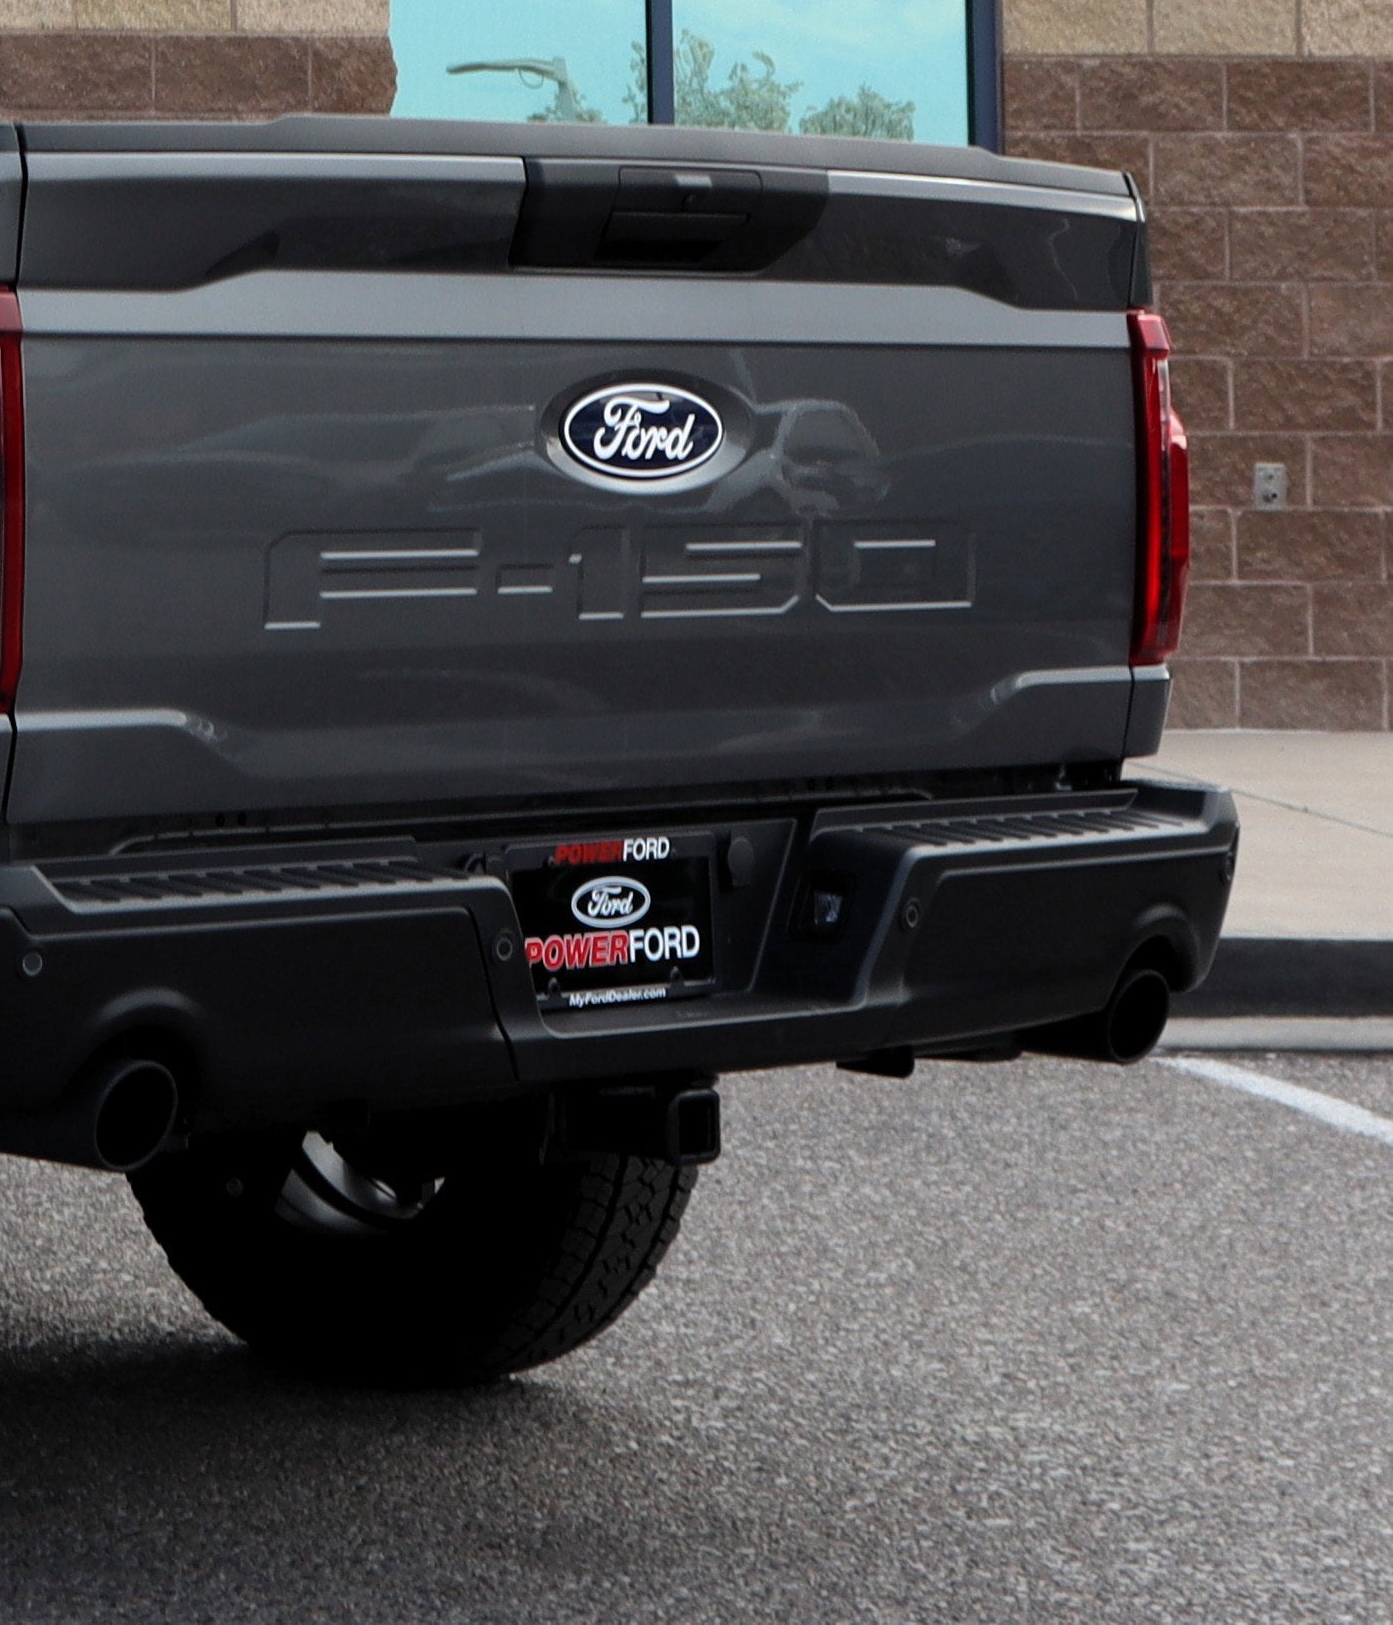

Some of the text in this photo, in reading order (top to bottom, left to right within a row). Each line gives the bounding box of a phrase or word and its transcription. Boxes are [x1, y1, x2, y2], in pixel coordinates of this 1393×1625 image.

[593, 394, 696, 461] Ford
[265, 518, 977, 631] F-150
[556, 836, 670, 866] POWERFORD
[587, 886, 634, 917] Ford
[524, 924, 701, 972] POWERFORD
